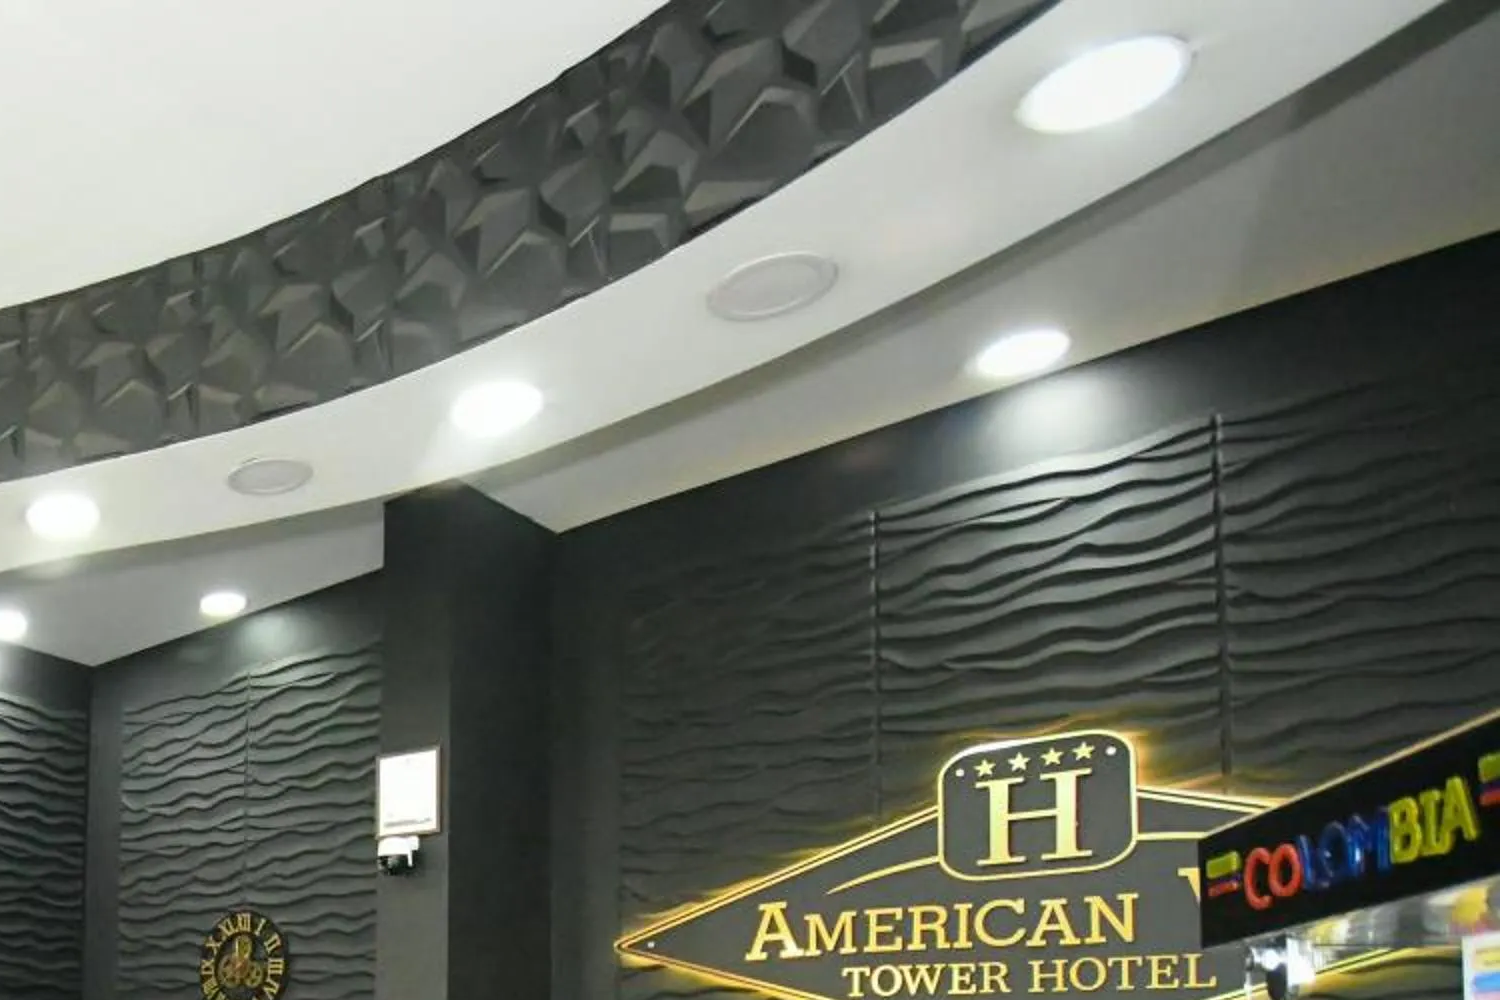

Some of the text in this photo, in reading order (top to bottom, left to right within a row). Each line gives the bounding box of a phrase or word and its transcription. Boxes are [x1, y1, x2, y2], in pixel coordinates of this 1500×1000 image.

[975, 766, 1093, 866] H
[1243, 776, 1478, 910] COLOMBIA
[841, 953, 1218, 998] TOWER HOTEL
